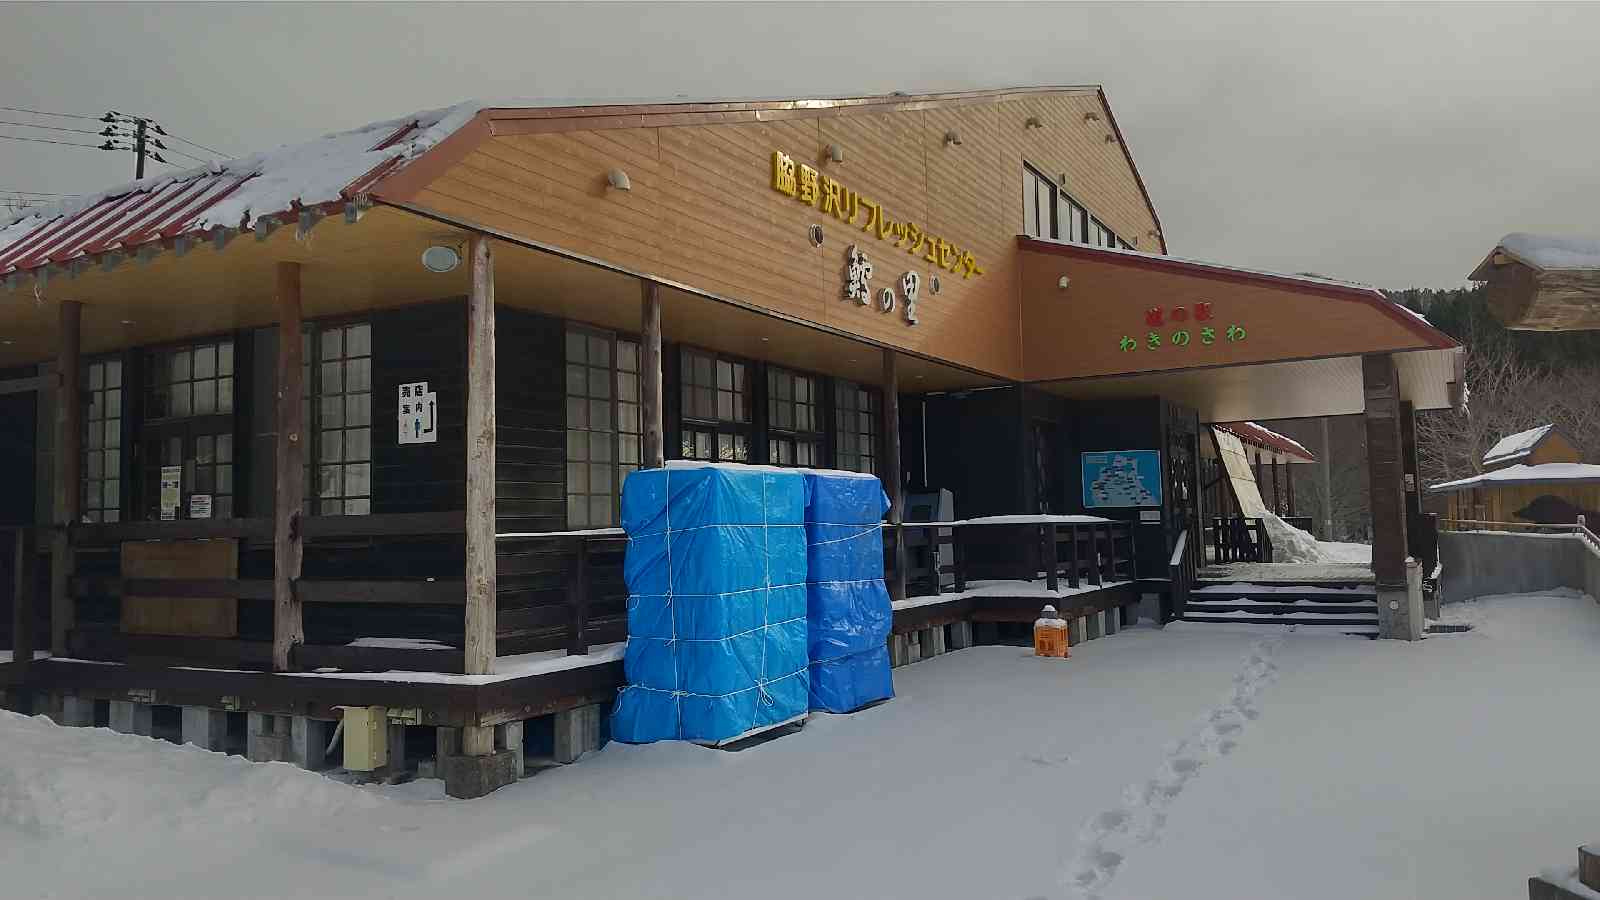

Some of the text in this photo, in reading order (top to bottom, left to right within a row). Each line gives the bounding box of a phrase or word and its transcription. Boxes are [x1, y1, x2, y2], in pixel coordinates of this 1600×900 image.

[772, 151, 984, 279] 脇野沢リフレッシュセンター
[1119, 324, 1247, 351] わきのさわ
